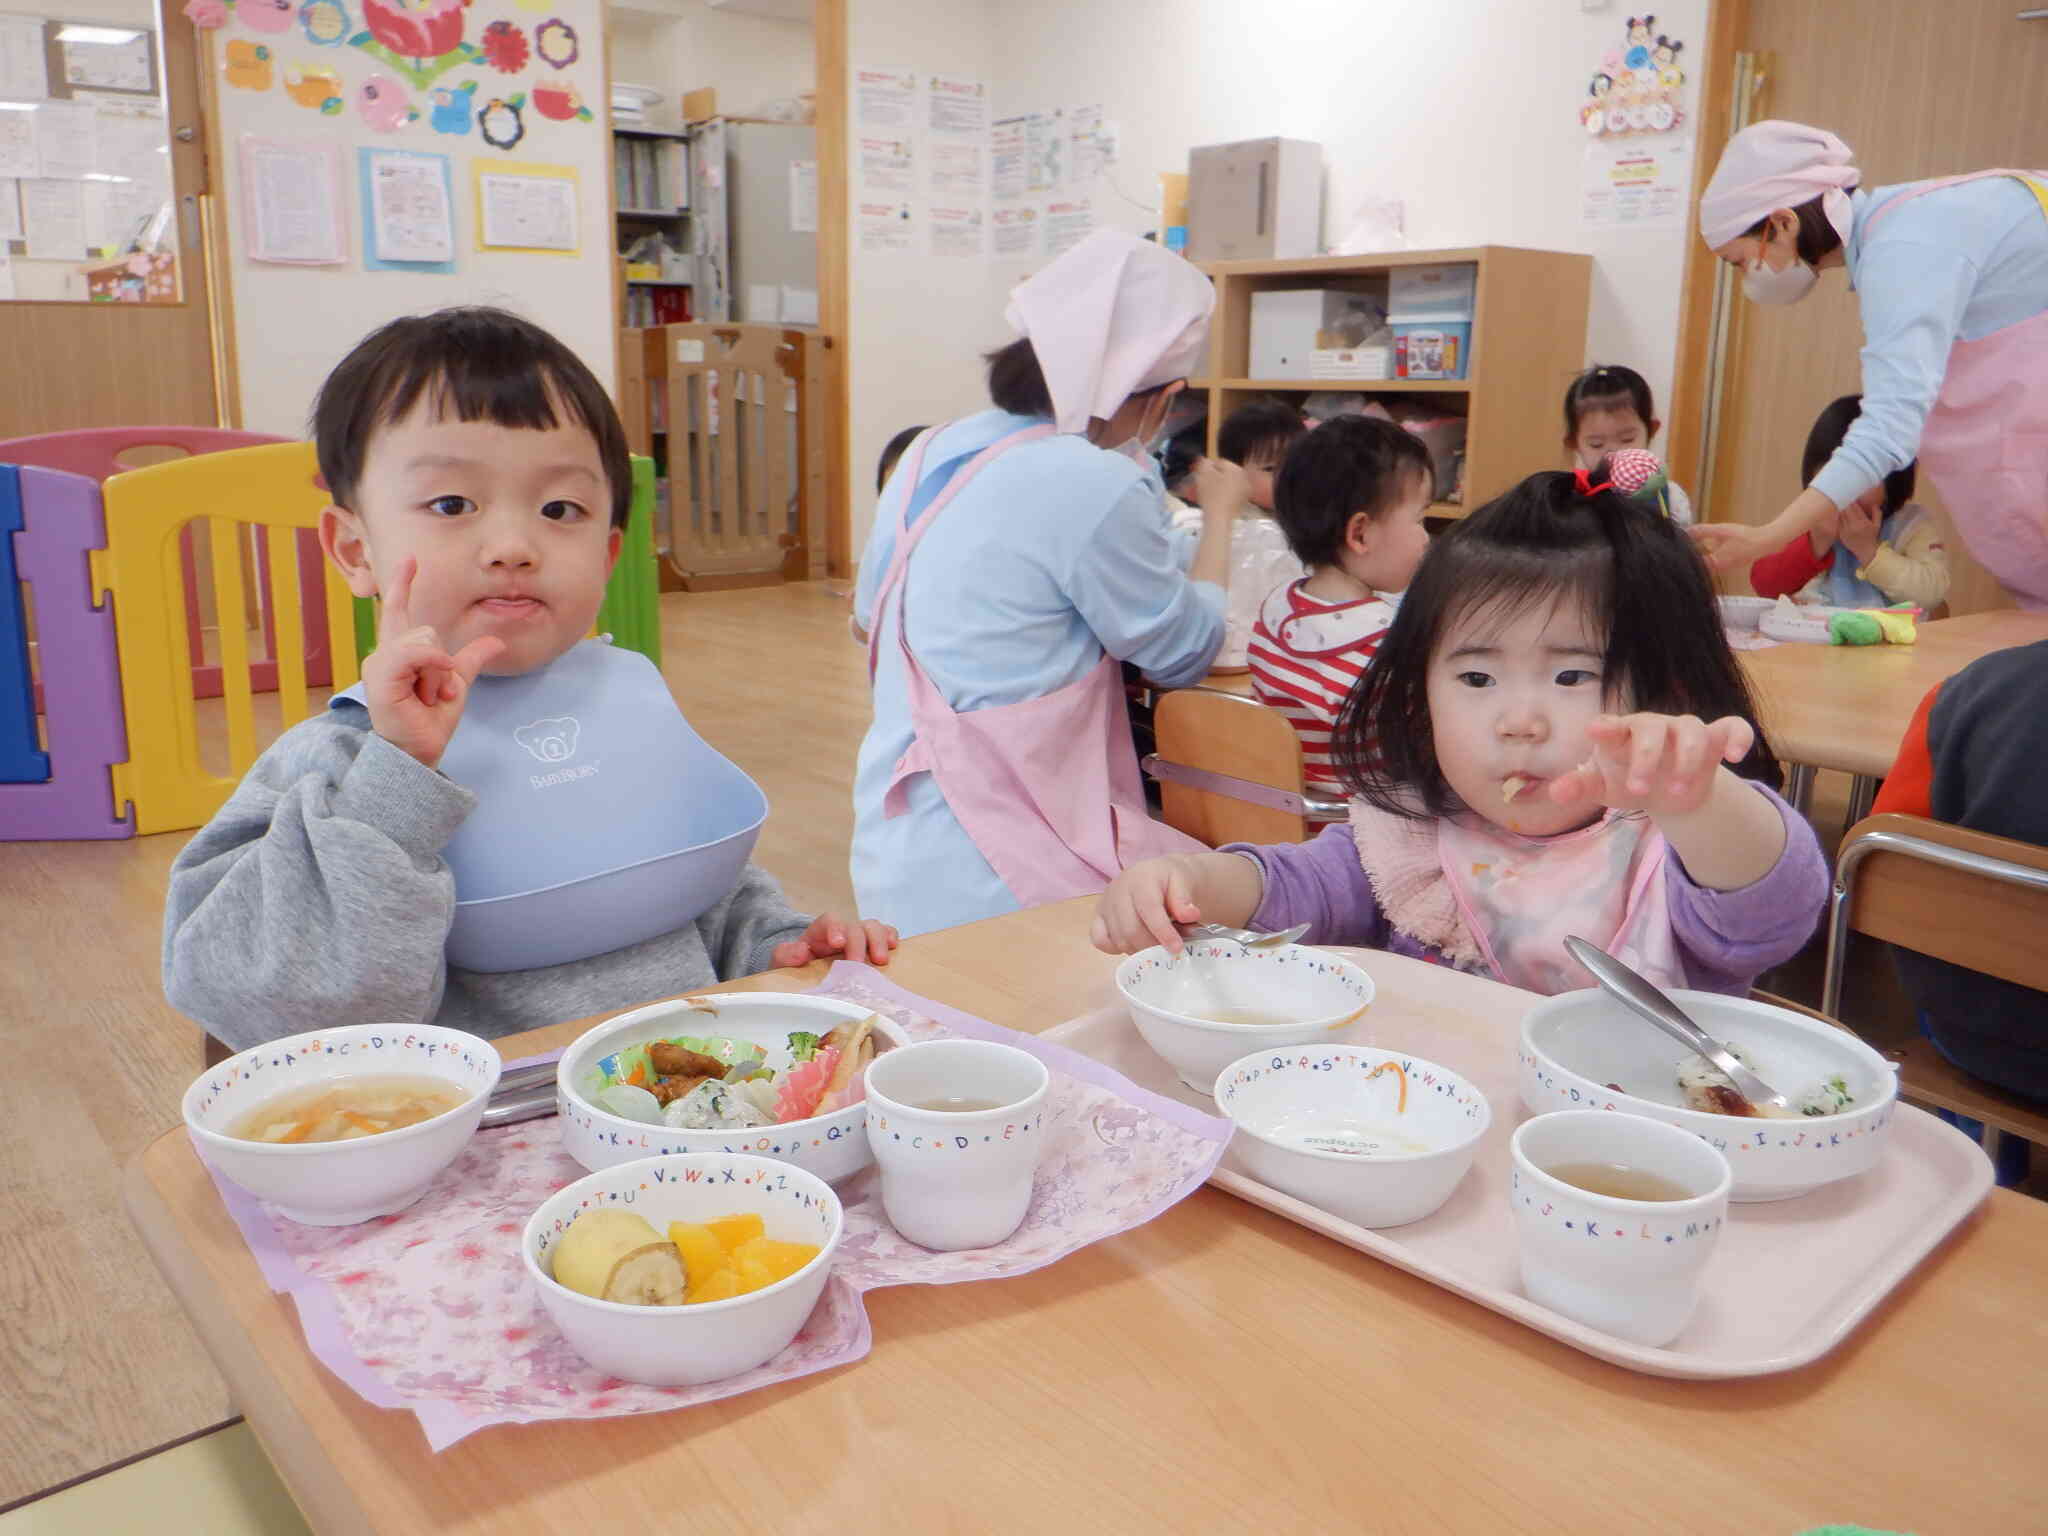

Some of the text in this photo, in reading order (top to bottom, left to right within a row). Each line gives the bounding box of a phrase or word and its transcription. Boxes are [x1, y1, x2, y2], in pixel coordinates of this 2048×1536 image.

[1186, 945, 1193, 956] V
[210, 1080, 221, 1096] X
[250, 1056, 264, 1071] Z
[286, 1053, 296, 1066] A
[340, 1043, 350, 1055] C
[371, 1036, 384, 1049] D
[404, 1034, 416, 1049] E
[428, 1044, 437, 1058] F
[1272, 1056, 1285, 1070] Q
[1298, 1056, 1308, 1070] R
[1322, 1059, 1332, 1072] S
[1402, 1060, 1412, 1073] V
[1424, 1072, 1437, 1086] W
[1446, 1084, 1455, 1096] X
[1570, 1088, 1580, 1102] D
[1754, 1132, 1767, 1146] I
[1830, 1132, 1840, 1147] K
[610, 1132, 619, 1146] K
[640, 1135, 649, 1148] L
[757, 1138, 770, 1150] O
[792, 1142, 801, 1154] P
[826, 1126, 843, 1140] Q
[912, 1136, 923, 1149] C
[955, 1136, 969, 1149] D
[1004, 1124, 1016, 1140] E
[538, 1232, 548, 1250] Q
[594, 1192, 605, 1206] T
[624, 1190, 636, 1204] U
[654, 1168, 665, 1183] V
[684, 1168, 704, 1184] W
[722, 1168, 736, 1184] X
[754, 1168, 768, 1184] Y
[776, 1175, 788, 1190] Z
[804, 1194, 812, 1208] A
[1586, 1221, 1600, 1237] K
[1640, 1224, 1652, 1240] L
[1686, 1222, 1699, 1239] M
